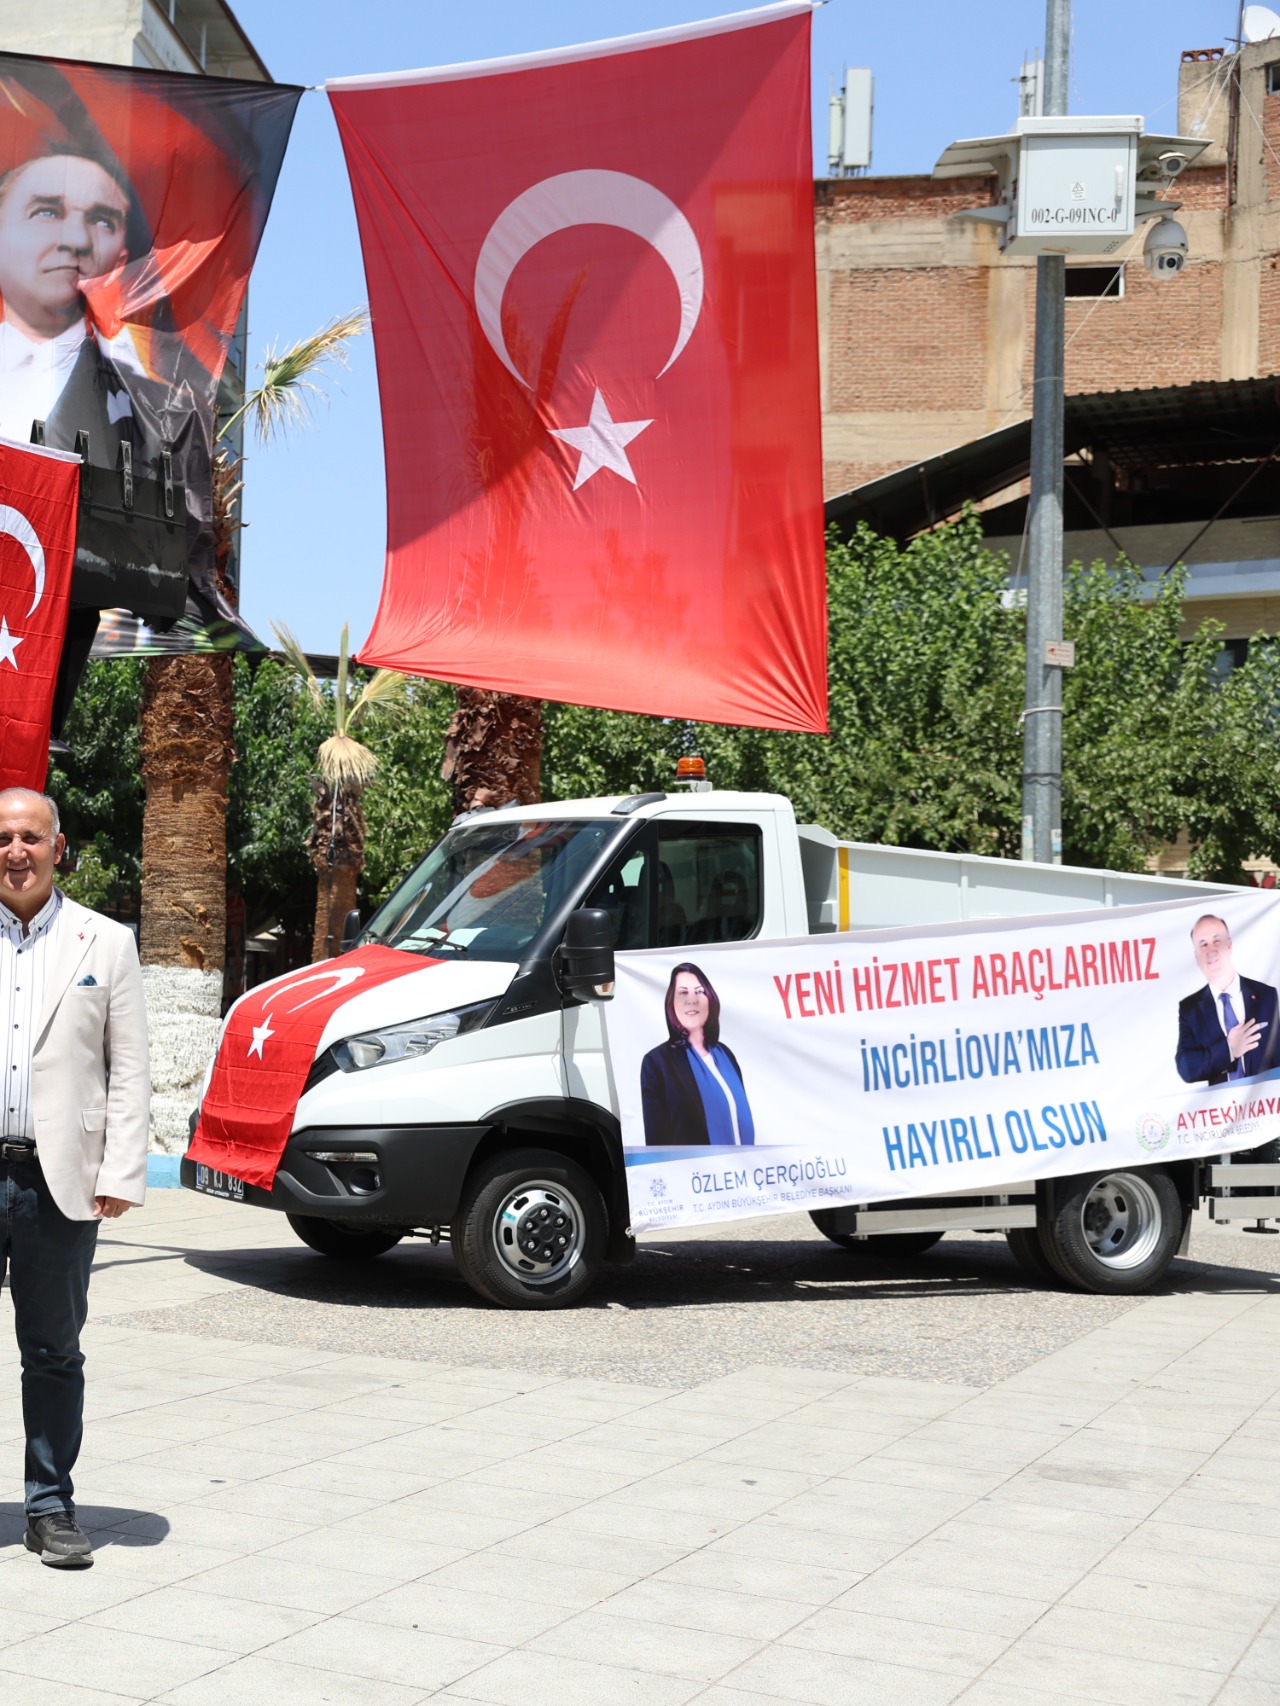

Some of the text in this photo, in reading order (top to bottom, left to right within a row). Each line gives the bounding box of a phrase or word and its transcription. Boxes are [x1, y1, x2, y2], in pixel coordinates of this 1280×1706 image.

[773, 937, 1160, 1019] YENİ HİZMET ARAÇLARIMIZ
[860, 1022, 1099, 1092] İNCİRLİOVA'MIZA
[882, 1100, 1107, 1171] HAYIRLI OLSUN
[1177, 1100, 1246, 1131] AYTEKİN
[691, 1156, 847, 1194] ÖZLEM ÇERÇİOĞLU
[693, 1185, 853, 1213] T.C. AYDIN BÜYÜKŞEHİR BELEDİYE BAŞKANI
